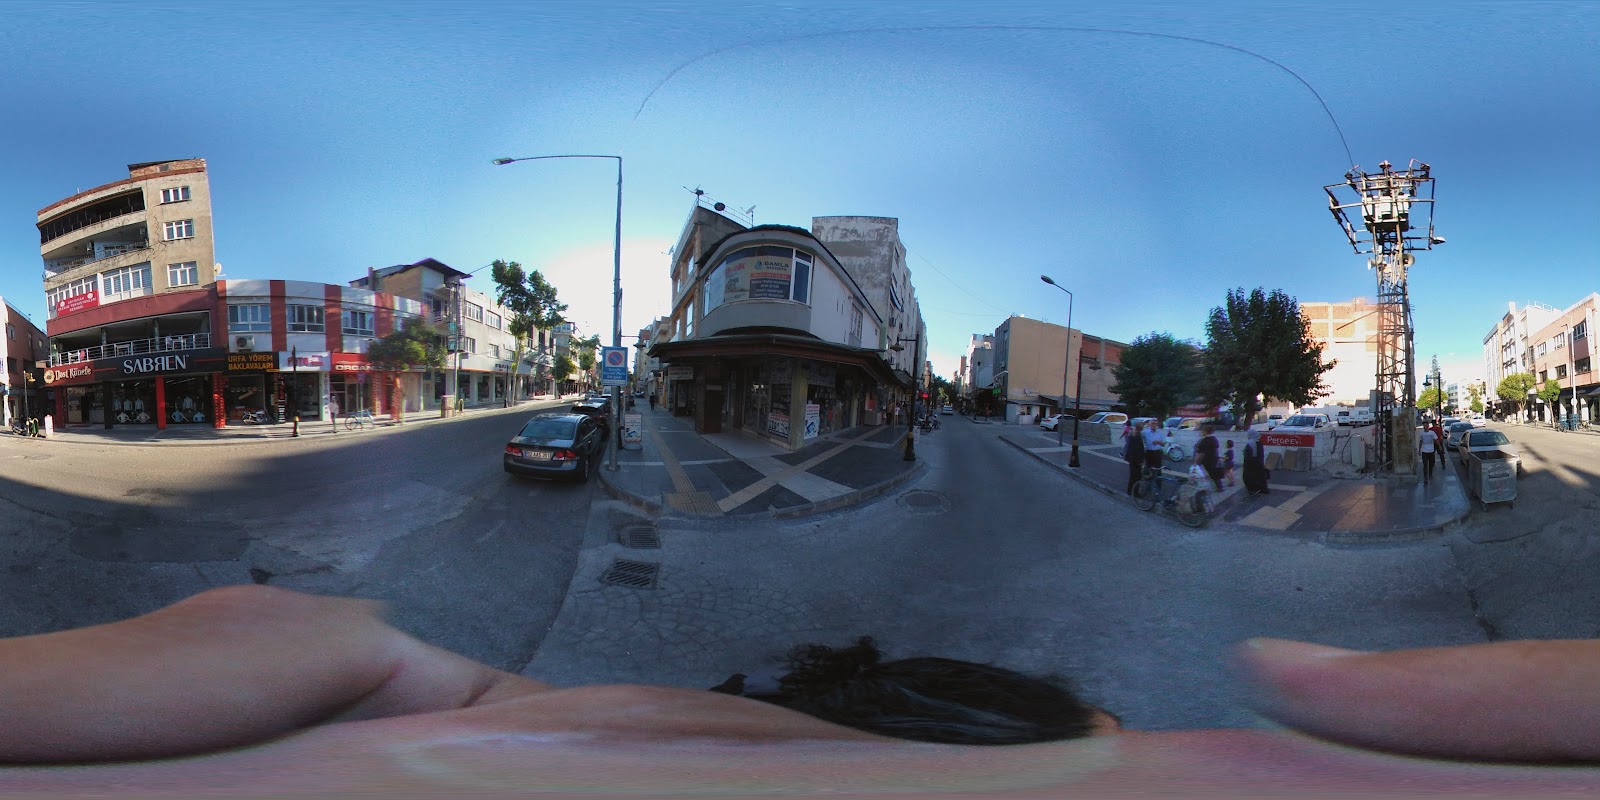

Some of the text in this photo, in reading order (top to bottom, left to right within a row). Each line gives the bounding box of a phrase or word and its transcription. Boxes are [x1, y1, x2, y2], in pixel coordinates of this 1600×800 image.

[248, 354, 273, 362] YÖREM
[228, 362, 274, 371] BAKLAVALARI
[55, 365, 92, 380] Dost Künefe
